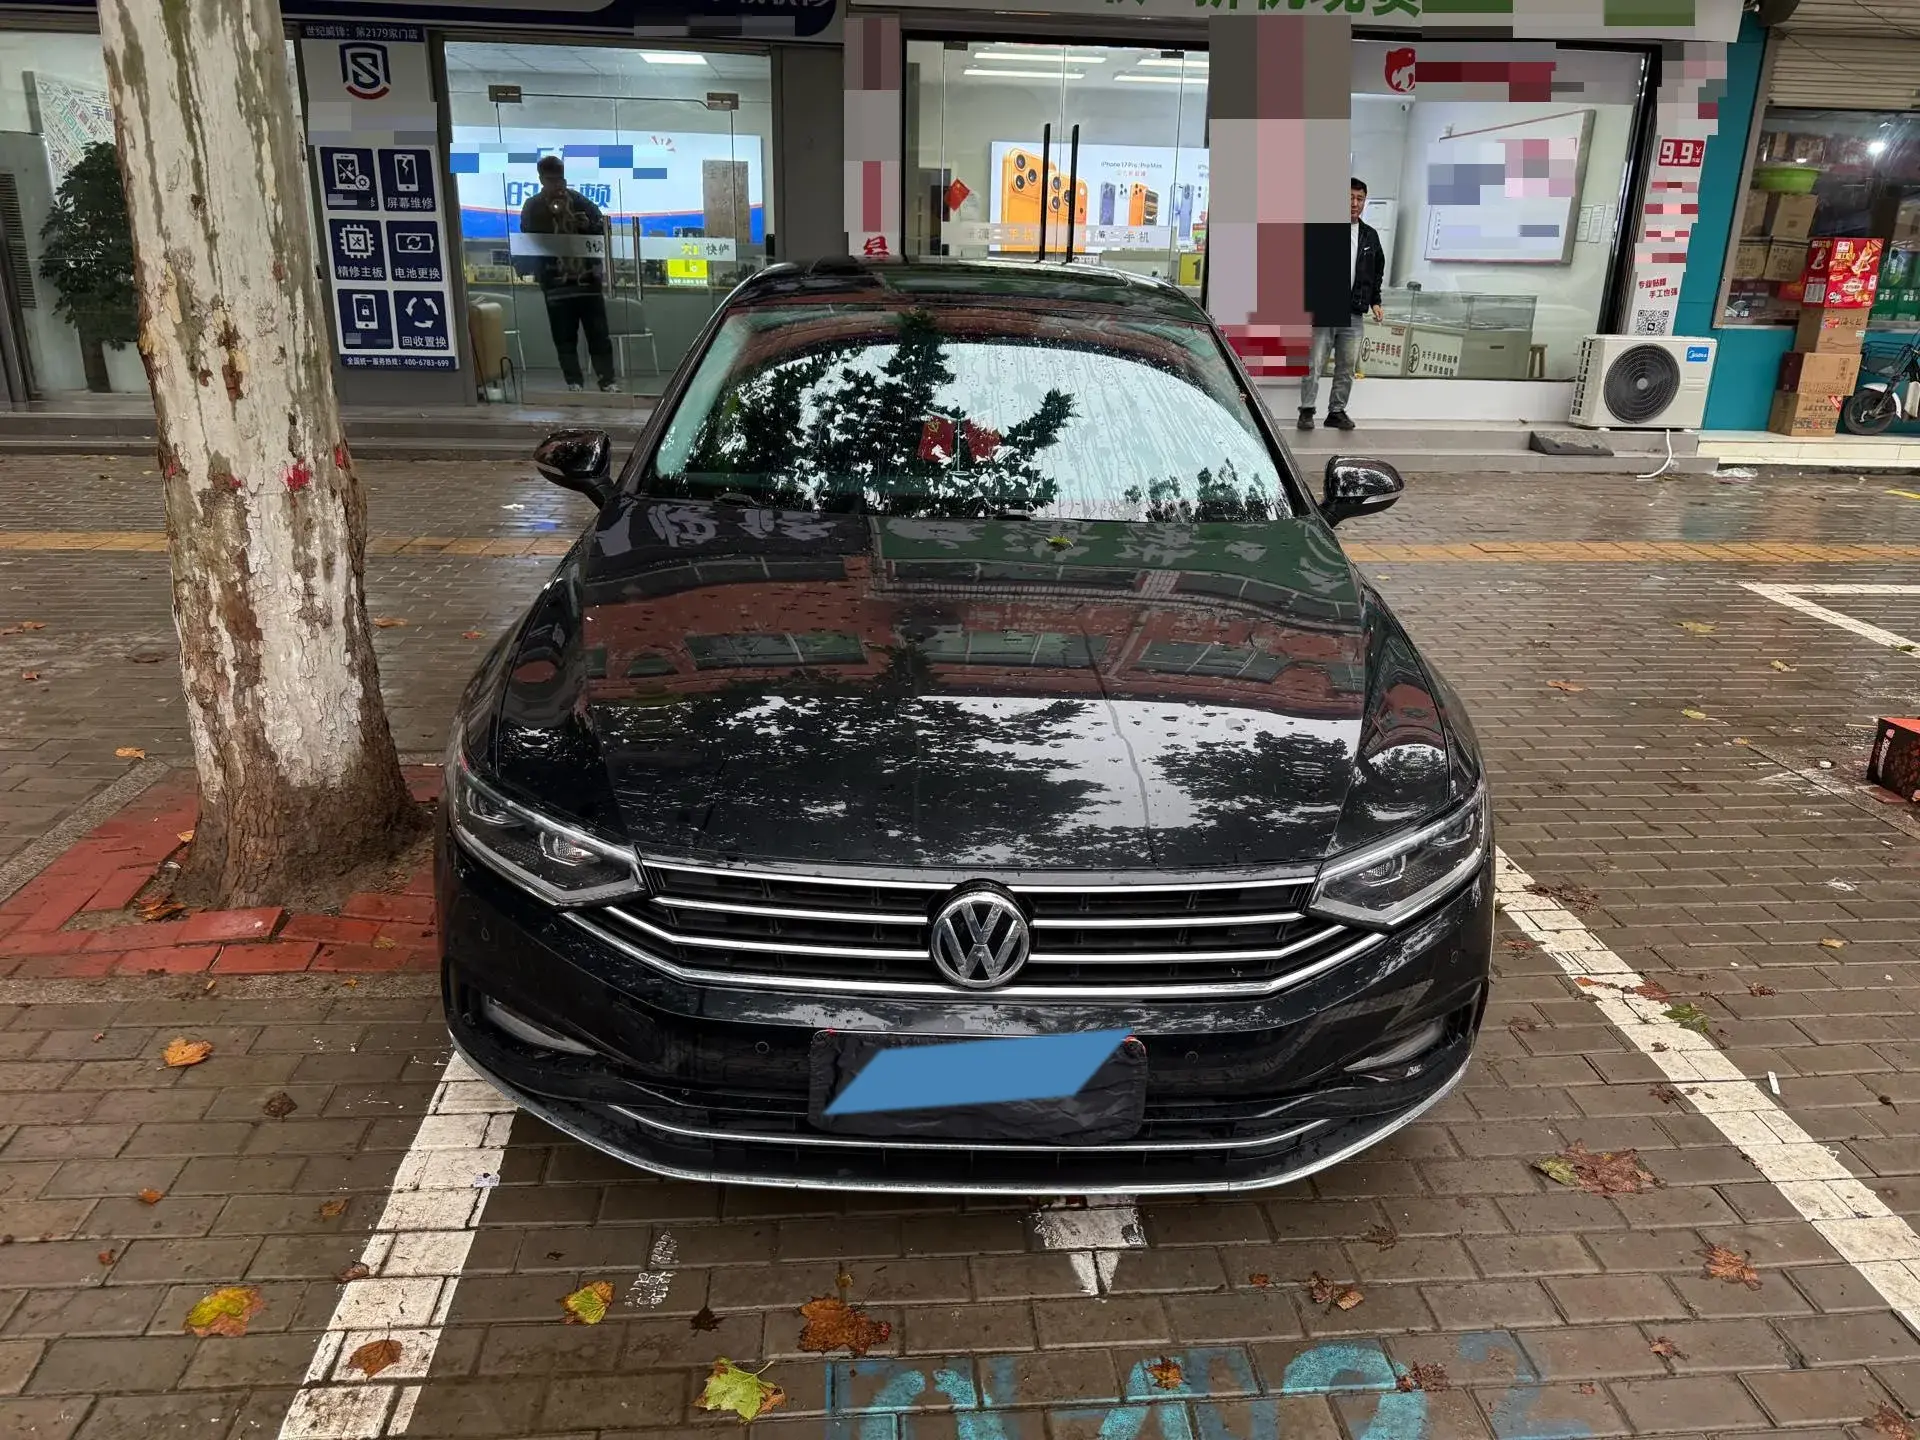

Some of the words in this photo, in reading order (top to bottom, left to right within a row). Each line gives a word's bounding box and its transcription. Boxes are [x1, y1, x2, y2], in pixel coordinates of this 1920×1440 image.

[387, 196, 434, 209] 屏幕维修
[337, 265, 384, 278] 精修主板
[394, 267, 441, 279] 电池更换
[1649, 288, 1678, 299] 手工也强
[402, 335, 447, 348] 回收置换
